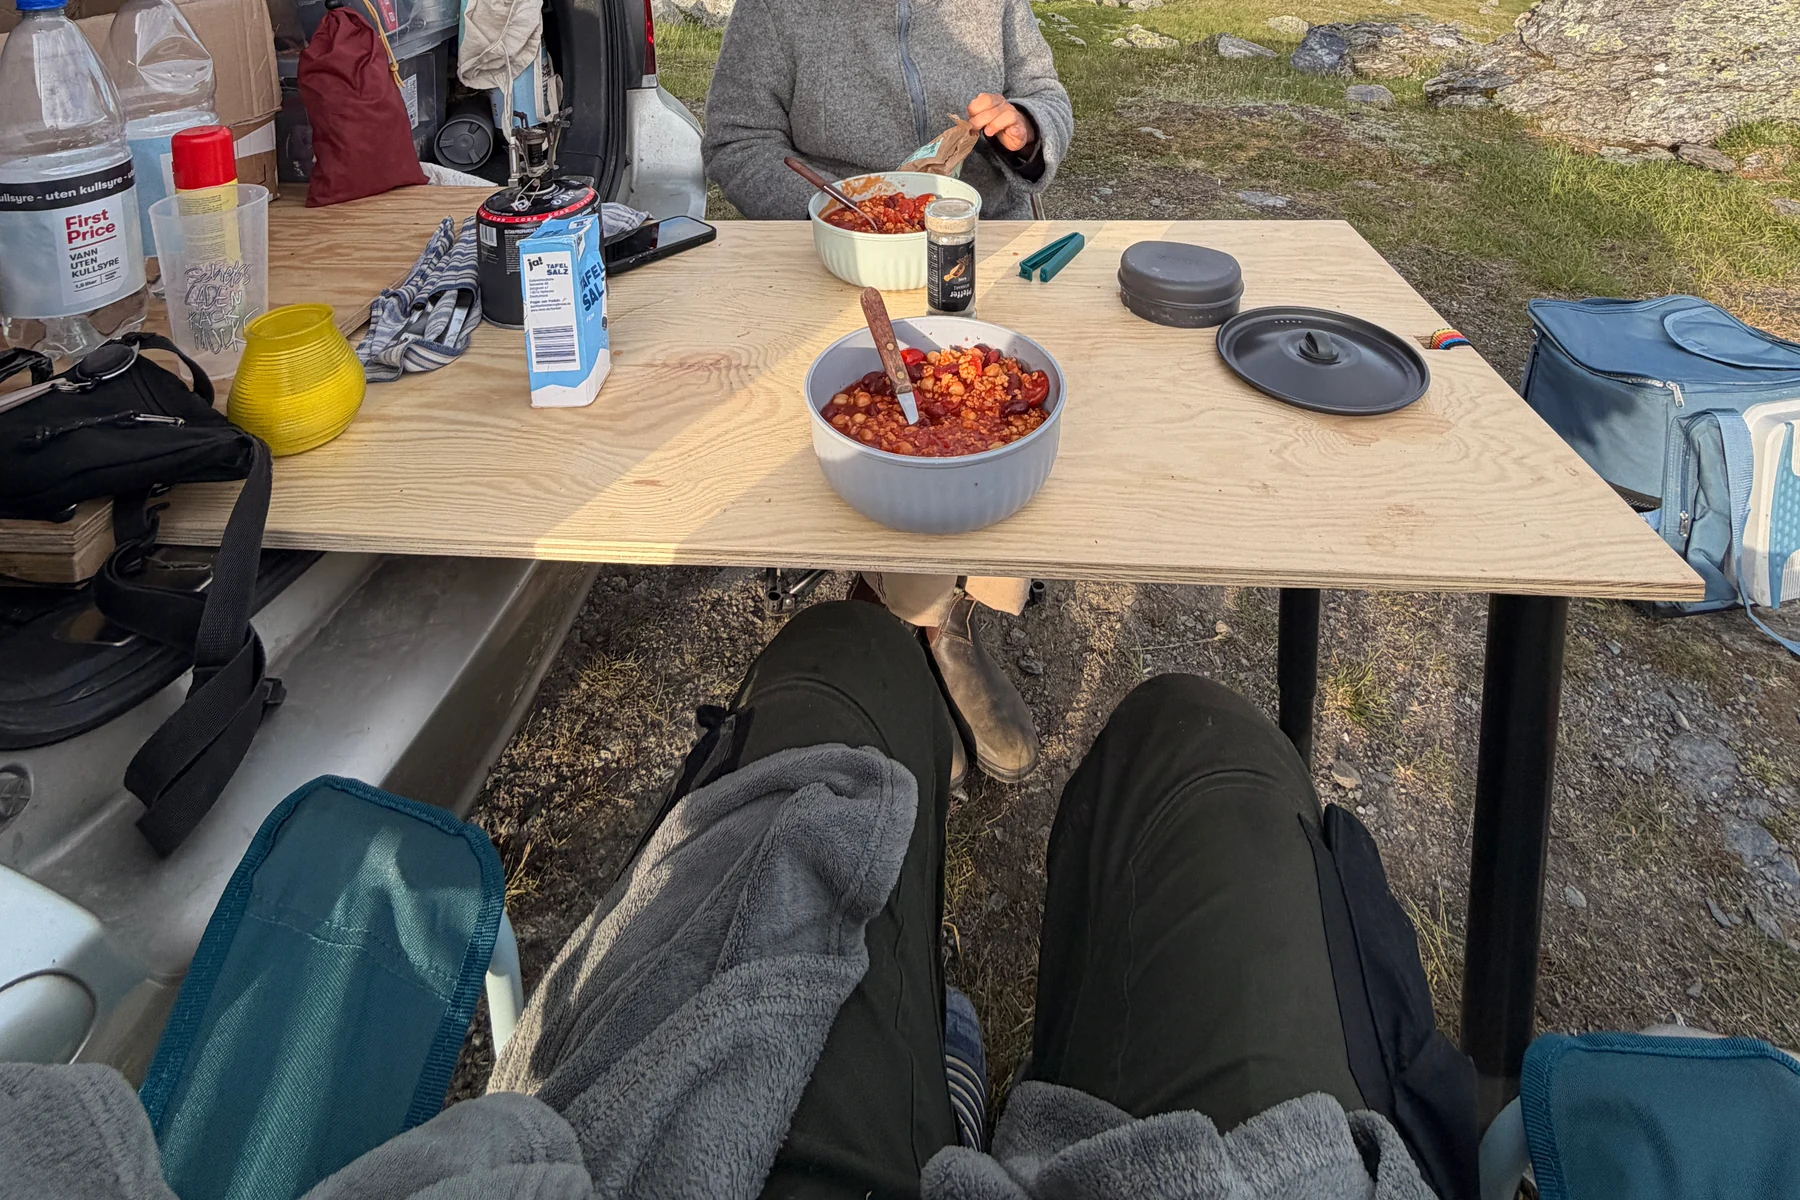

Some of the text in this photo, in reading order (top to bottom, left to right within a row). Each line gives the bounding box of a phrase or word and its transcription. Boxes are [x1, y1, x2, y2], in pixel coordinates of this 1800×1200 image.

[45, 189, 77, 201] uten
[79, 176, 123, 195] kullsyre
[65, 209, 109, 231] First
[67, 222, 116, 245] Price
[69, 248, 98, 261] VANN
[70, 257, 98, 270] UTEN
[527, 256, 543, 271] ja!
[71, 257, 120, 279] KULLSYRE
[583, 277, 604, 312] SAL
